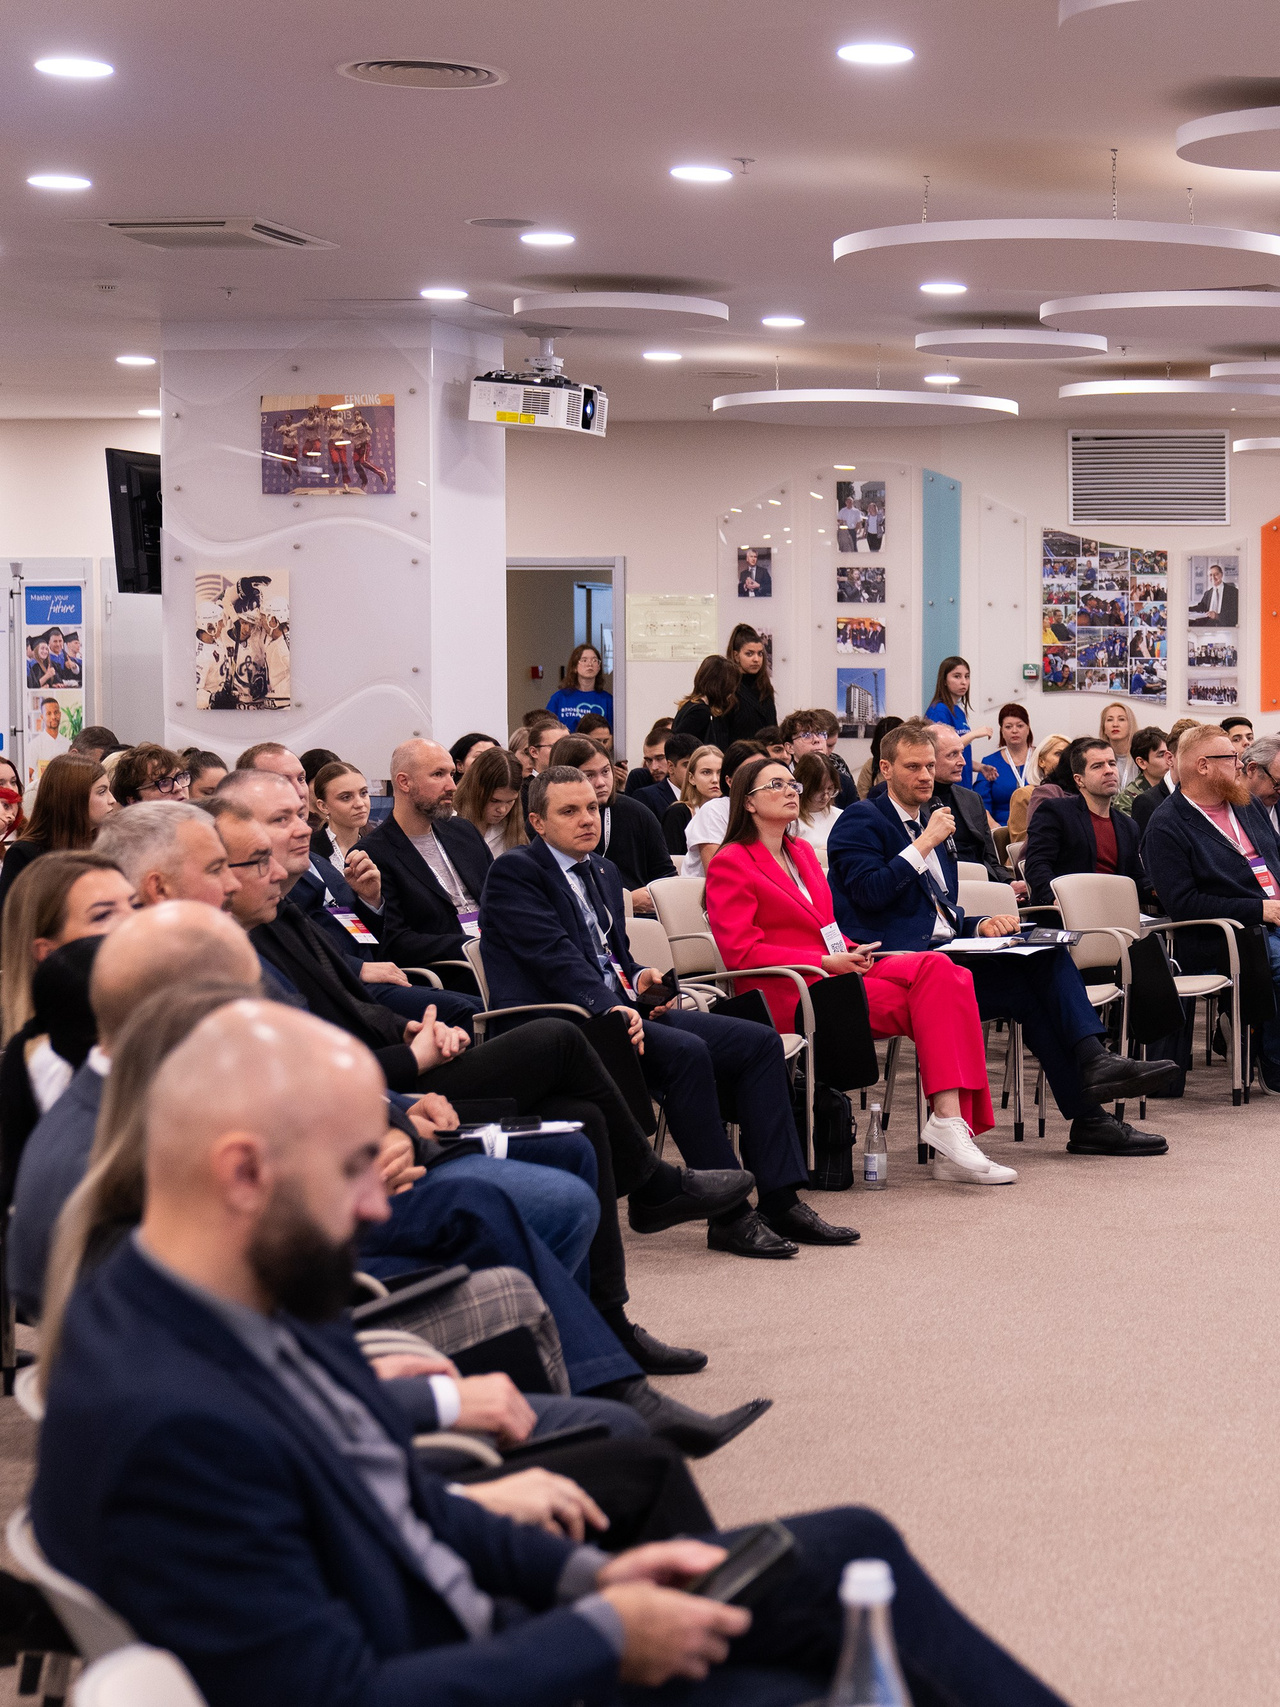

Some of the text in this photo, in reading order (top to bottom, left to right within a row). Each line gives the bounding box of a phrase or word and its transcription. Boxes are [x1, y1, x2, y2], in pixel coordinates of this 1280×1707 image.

[344, 394, 380, 405] FENCING
[54, 594, 69, 602] your
[47, 599, 76, 621] future
